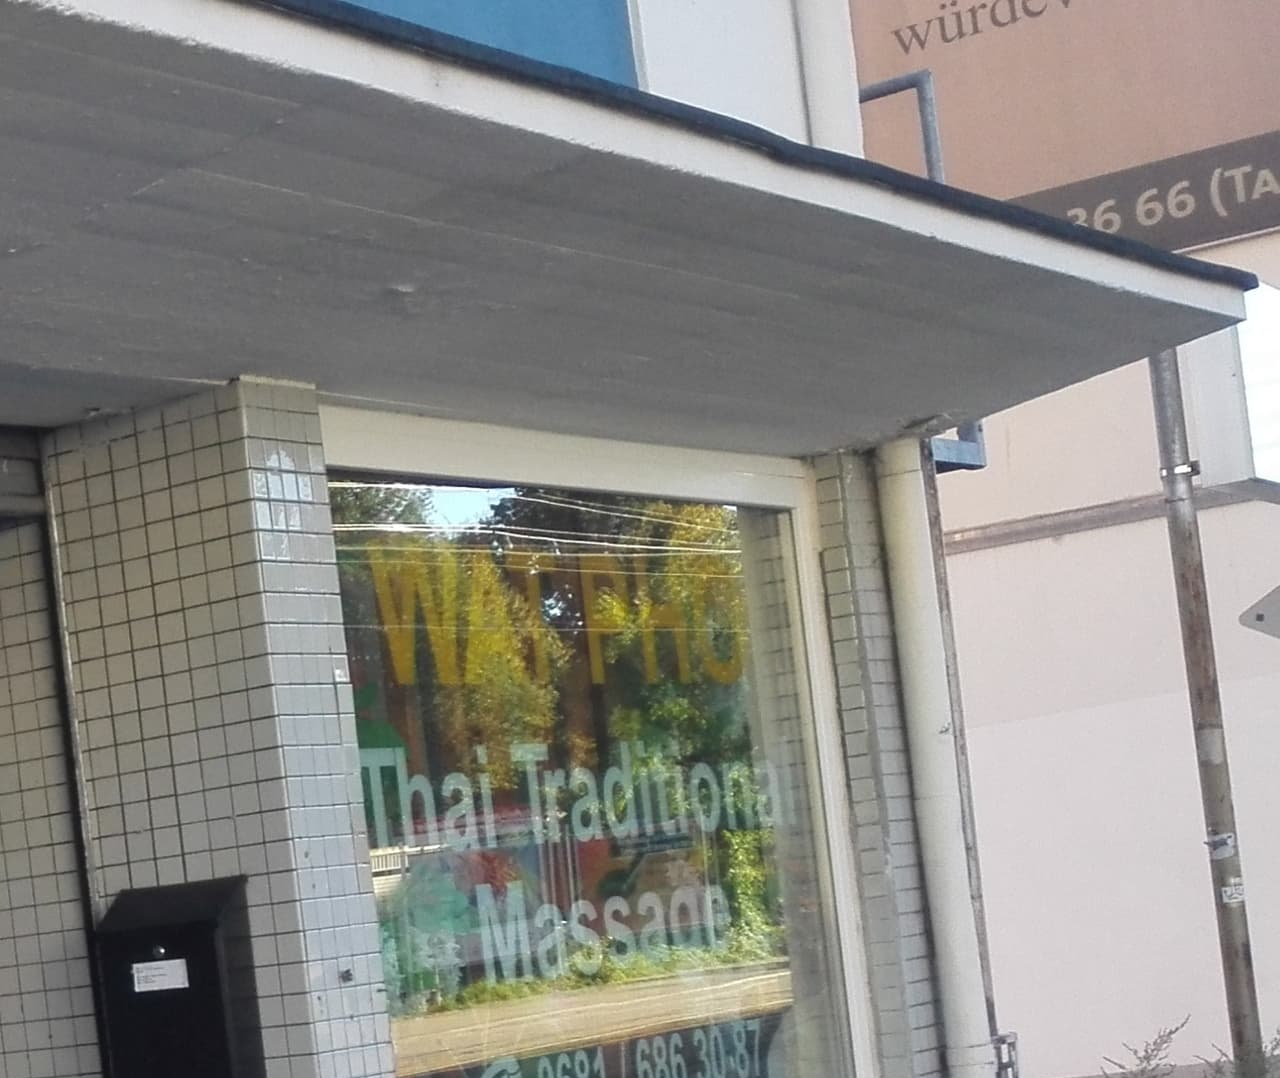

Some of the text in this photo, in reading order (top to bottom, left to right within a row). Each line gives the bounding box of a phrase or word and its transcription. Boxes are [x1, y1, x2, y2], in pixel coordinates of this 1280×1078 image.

[890, 0, 1073, 56] würde
[1135, 181, 1197, 227] 66
[358, 745, 501, 850] Thai
[474, 880, 732, 983] Massage
